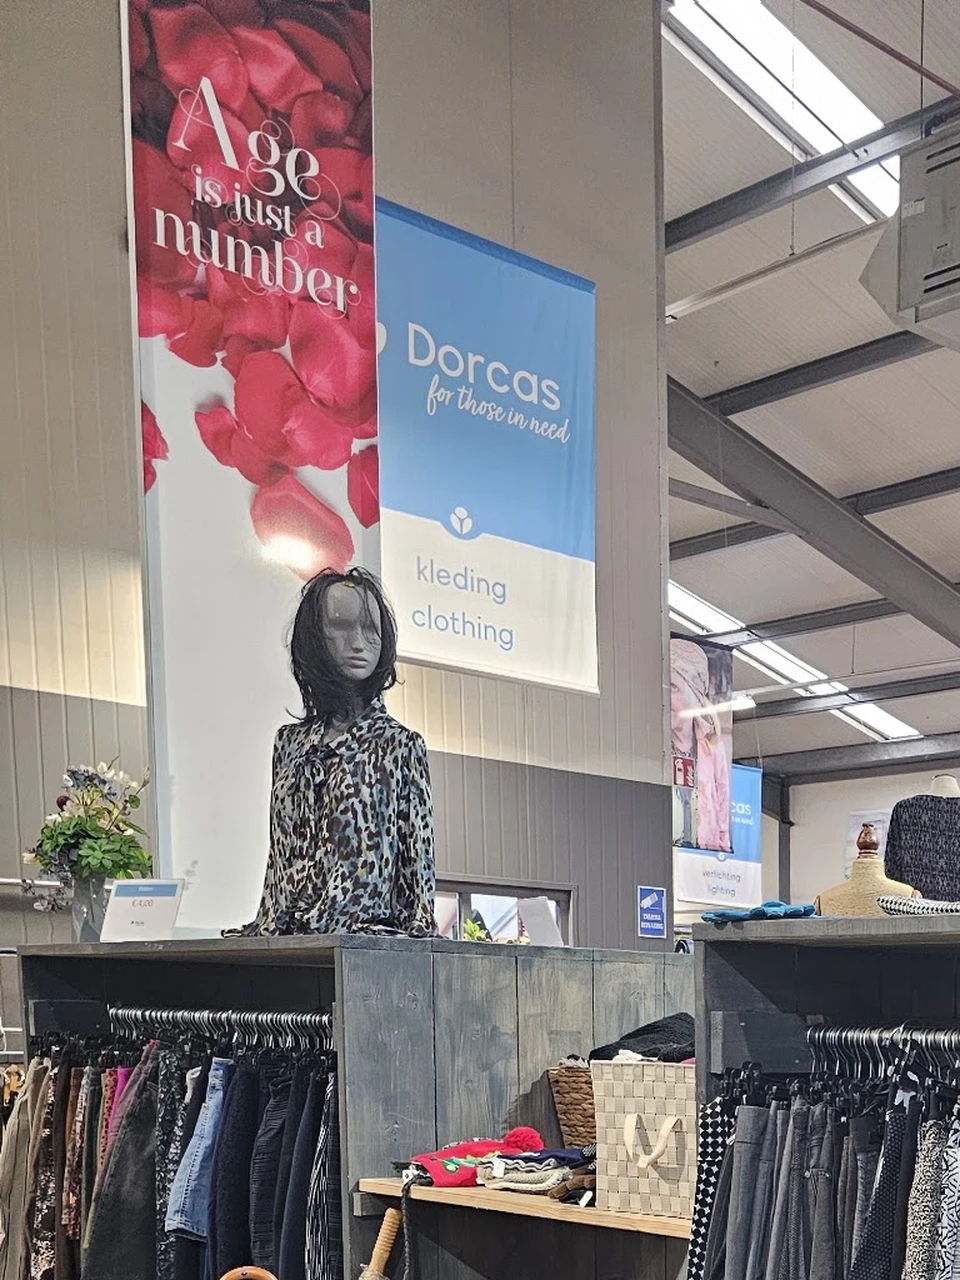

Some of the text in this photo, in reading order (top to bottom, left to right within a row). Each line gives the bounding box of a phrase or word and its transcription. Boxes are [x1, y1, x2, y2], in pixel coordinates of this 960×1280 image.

[172, 76, 335, 214] Age
[192, 166, 325, 249] is just a
[153, 207, 361, 318] number
[407, 321, 561, 411] Dorcas
[426, 373, 571, 443] for those in need
[416, 555, 507, 605] kleding
[411, 604, 513, 651] clothing
